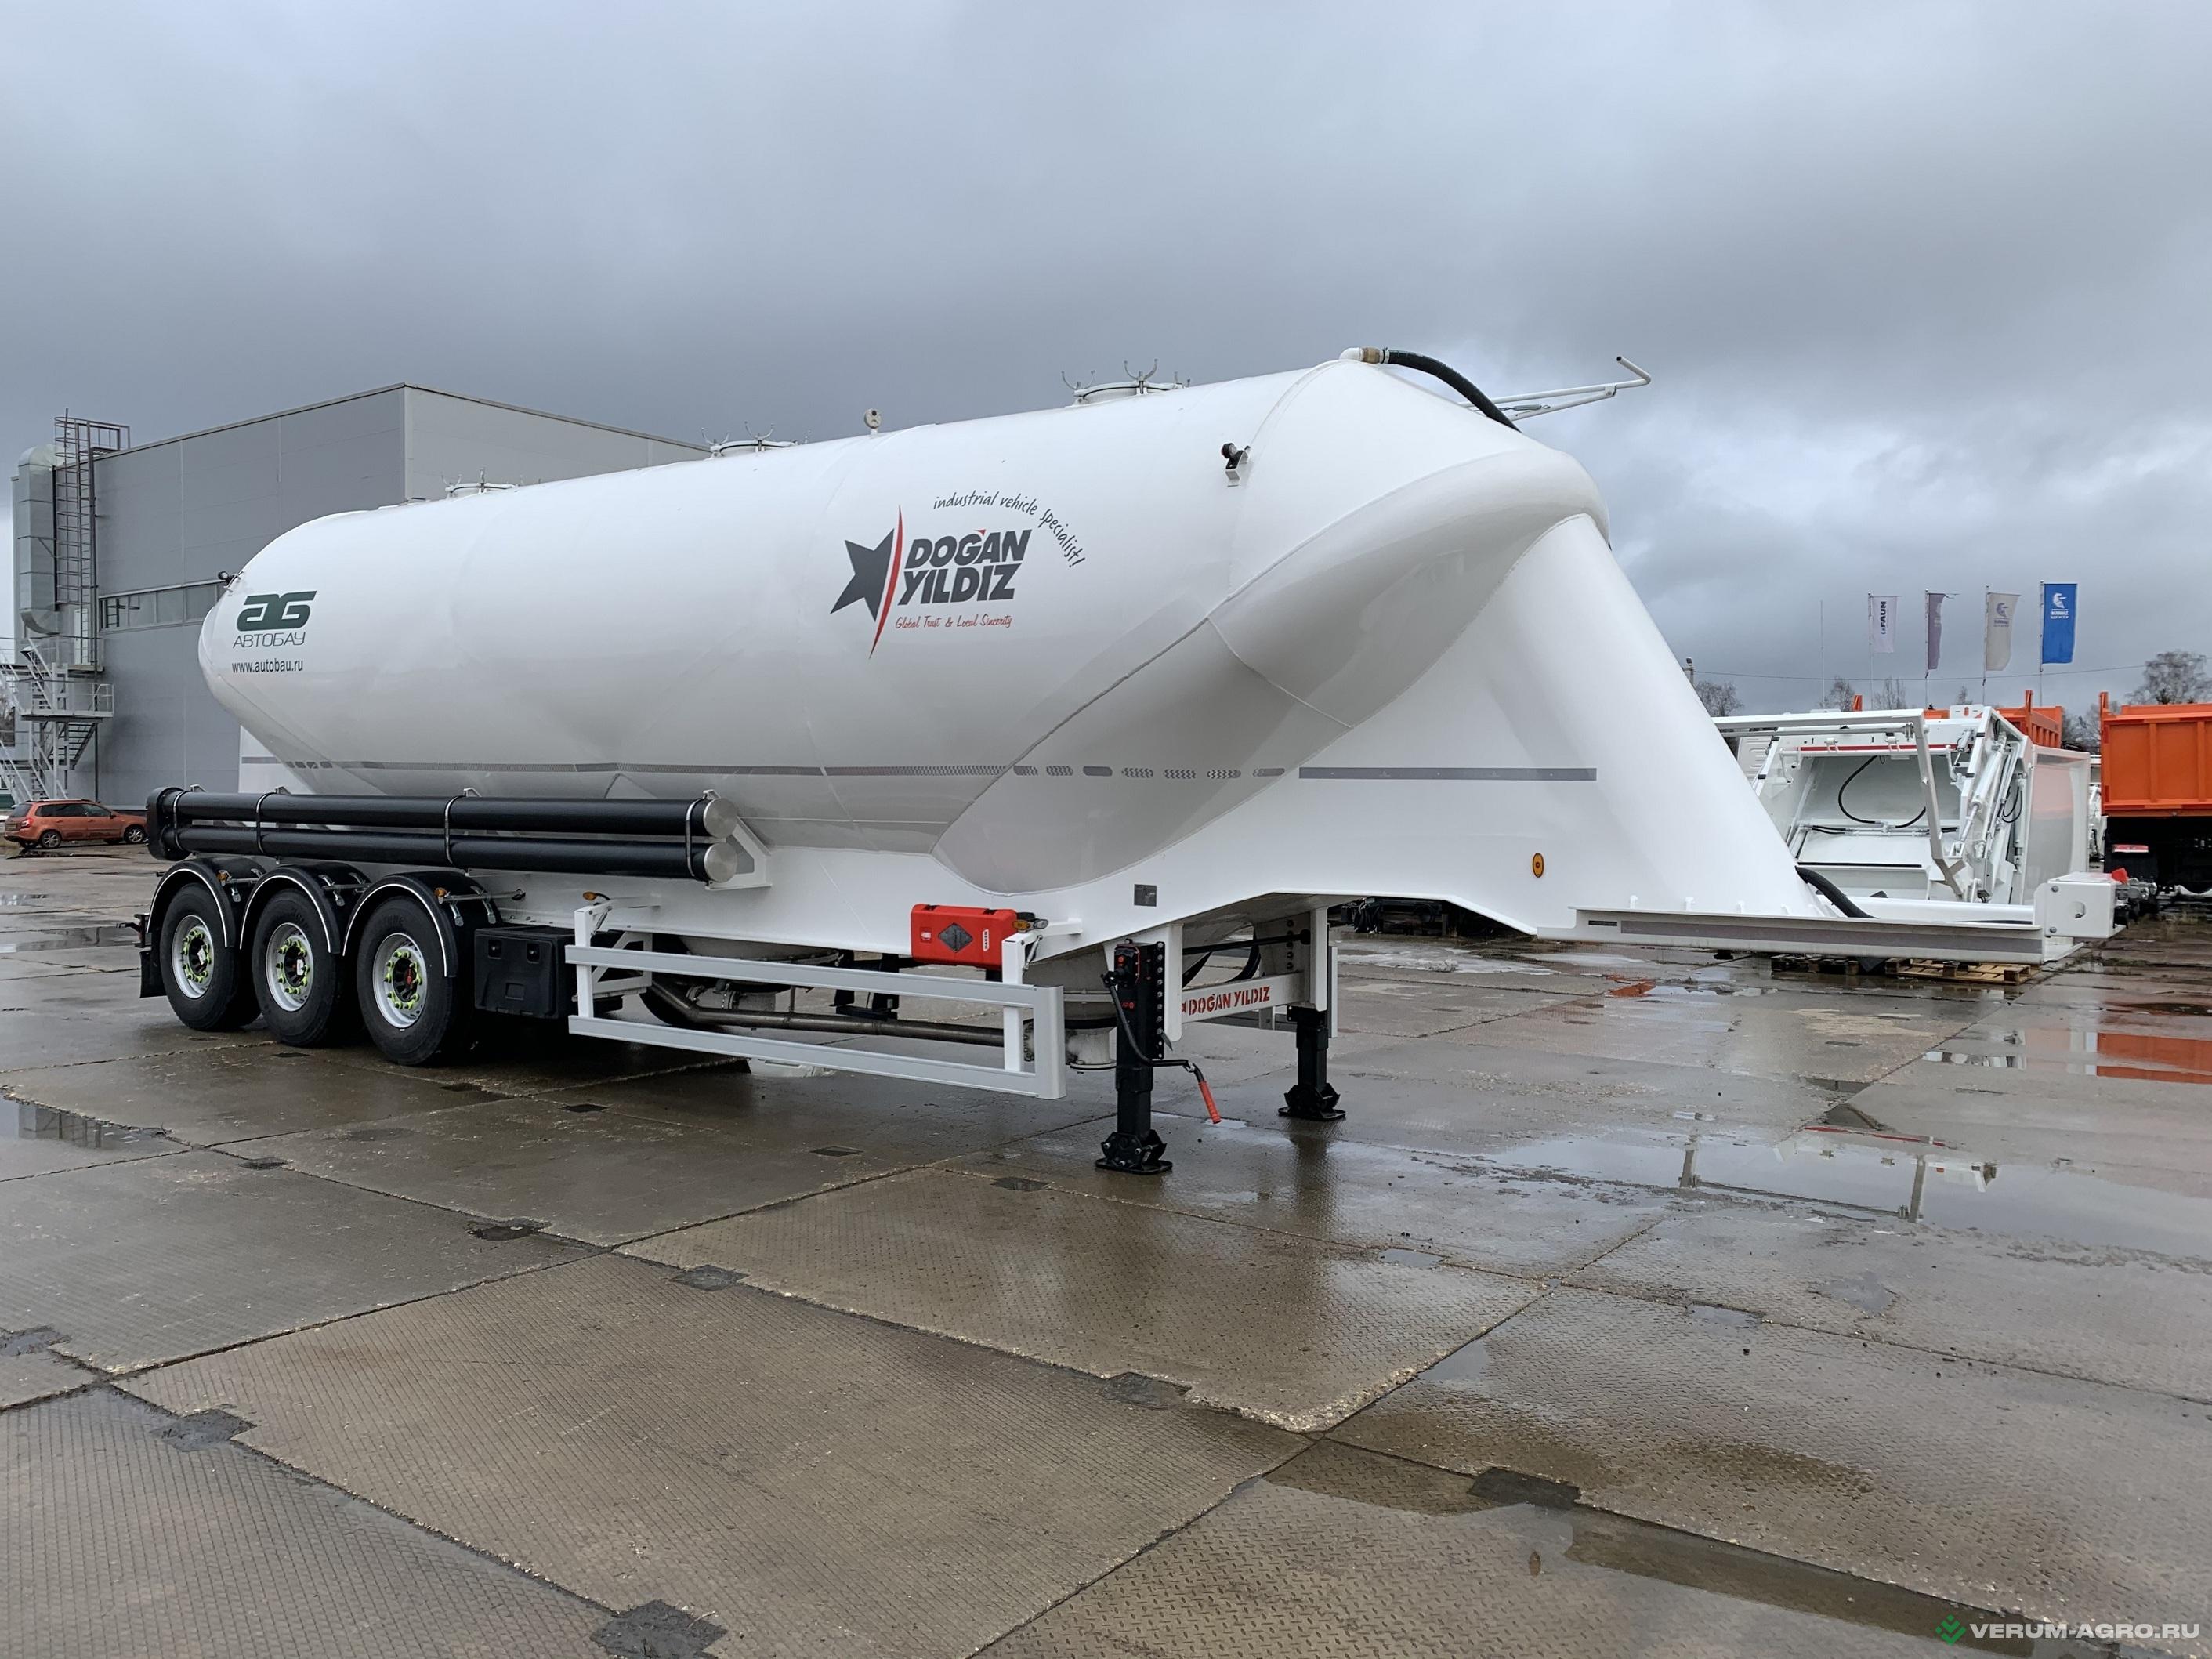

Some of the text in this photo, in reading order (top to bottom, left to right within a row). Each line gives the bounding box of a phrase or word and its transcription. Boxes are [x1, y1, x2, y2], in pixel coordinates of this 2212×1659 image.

[933, 490, 1086, 568] industrial vehicle specialist!
[895, 614, 1012, 628] Global Trust & Local Sincerity
[233, 632, 306, 649] АВТОБАУ
[232, 658, 303, 673] www.autobau.ru
